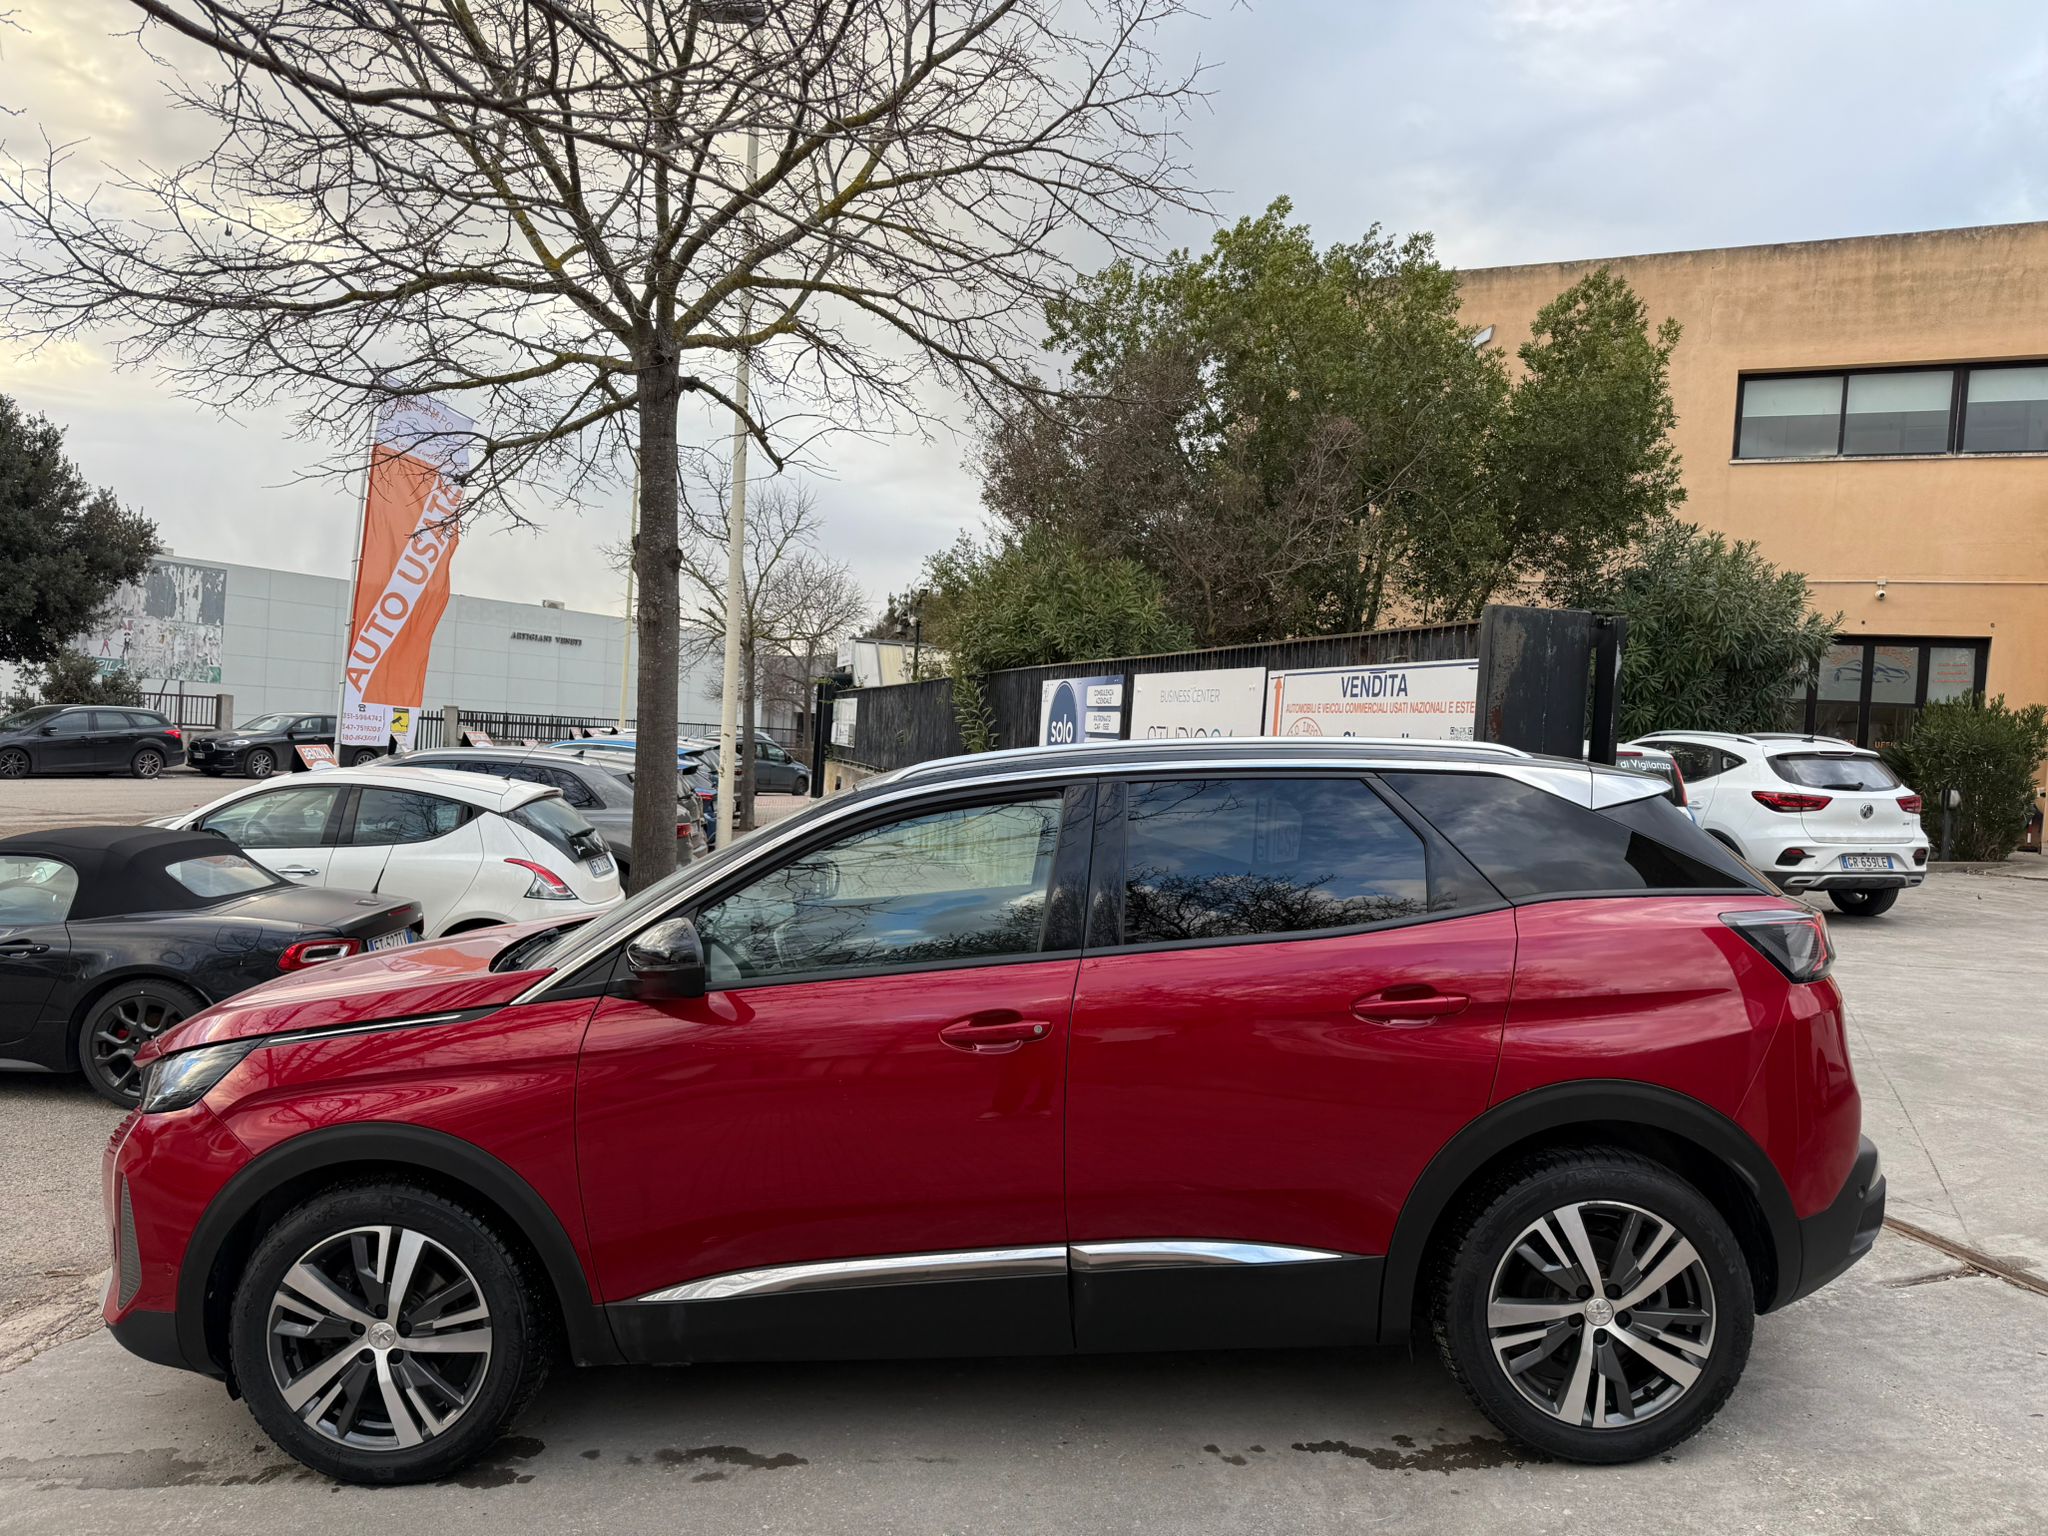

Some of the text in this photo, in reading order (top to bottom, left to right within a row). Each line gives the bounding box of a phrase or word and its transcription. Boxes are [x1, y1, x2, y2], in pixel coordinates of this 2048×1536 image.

[346, 592, 409, 694] AUTO
[1341, 673, 1408, 698] VENDITA
[1160, 689, 1220, 703] BUSINESS CENTER
[1286, 703, 1317, 714] AUTOMOBILI
[1322, 703, 1344, 713] VEICOLI
[1345, 702, 1388, 714] COMMERCIALI
[1389, 702, 1408, 713] USATI
[1410, 702, 1447, 713] NAZIONALI
[1448, 701, 1454, 713] E
[1051, 713, 1073, 743] solo
[1620, 760, 1671, 771] di Vigilanza
